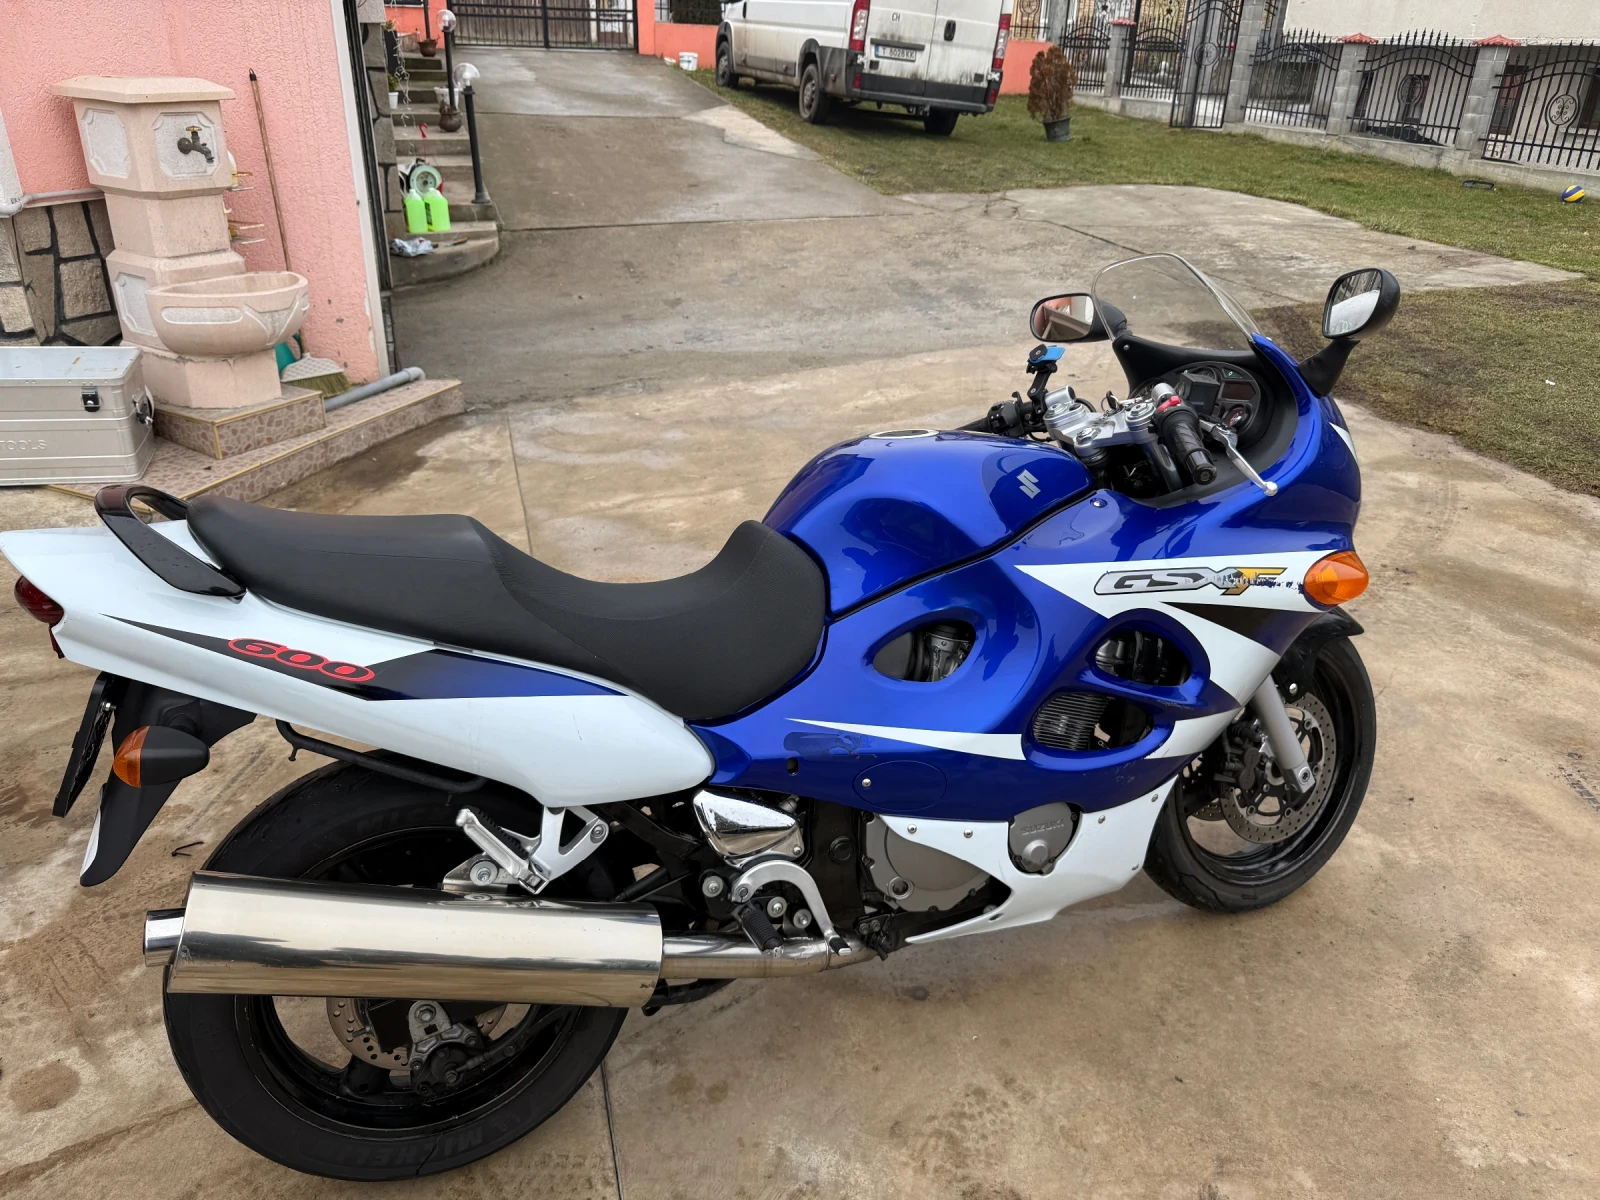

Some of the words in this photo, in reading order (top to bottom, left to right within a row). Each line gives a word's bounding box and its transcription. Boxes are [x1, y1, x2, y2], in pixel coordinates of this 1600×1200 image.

[891, 12, 901, 22] CH
[227, 637, 376, 682] 600
[1020, 818, 1064, 835] SUZUKI
